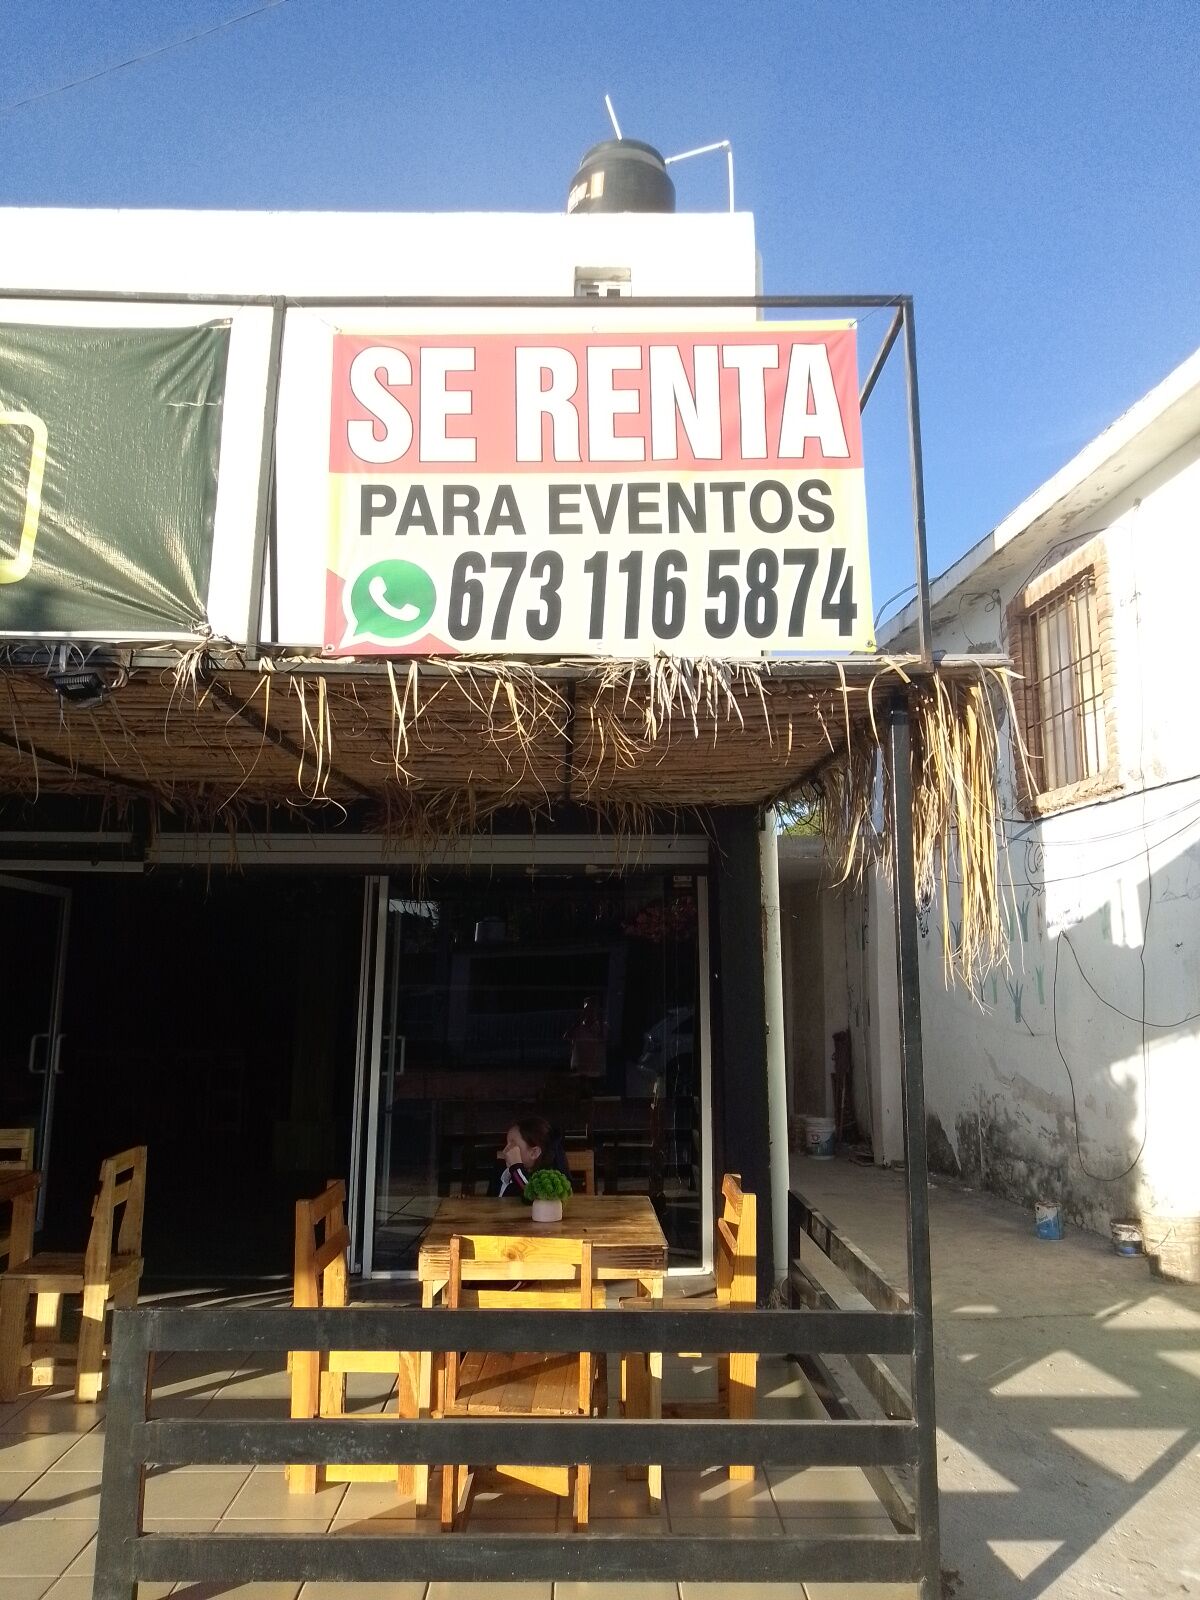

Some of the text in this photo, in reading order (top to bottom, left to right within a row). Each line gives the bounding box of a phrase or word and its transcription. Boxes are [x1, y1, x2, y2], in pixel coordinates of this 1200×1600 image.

[347, 343, 850, 463] SE RENTA
[360, 479, 835, 536] PARA EVENTOS
[447, 548, 858, 641] 673 116 5874
